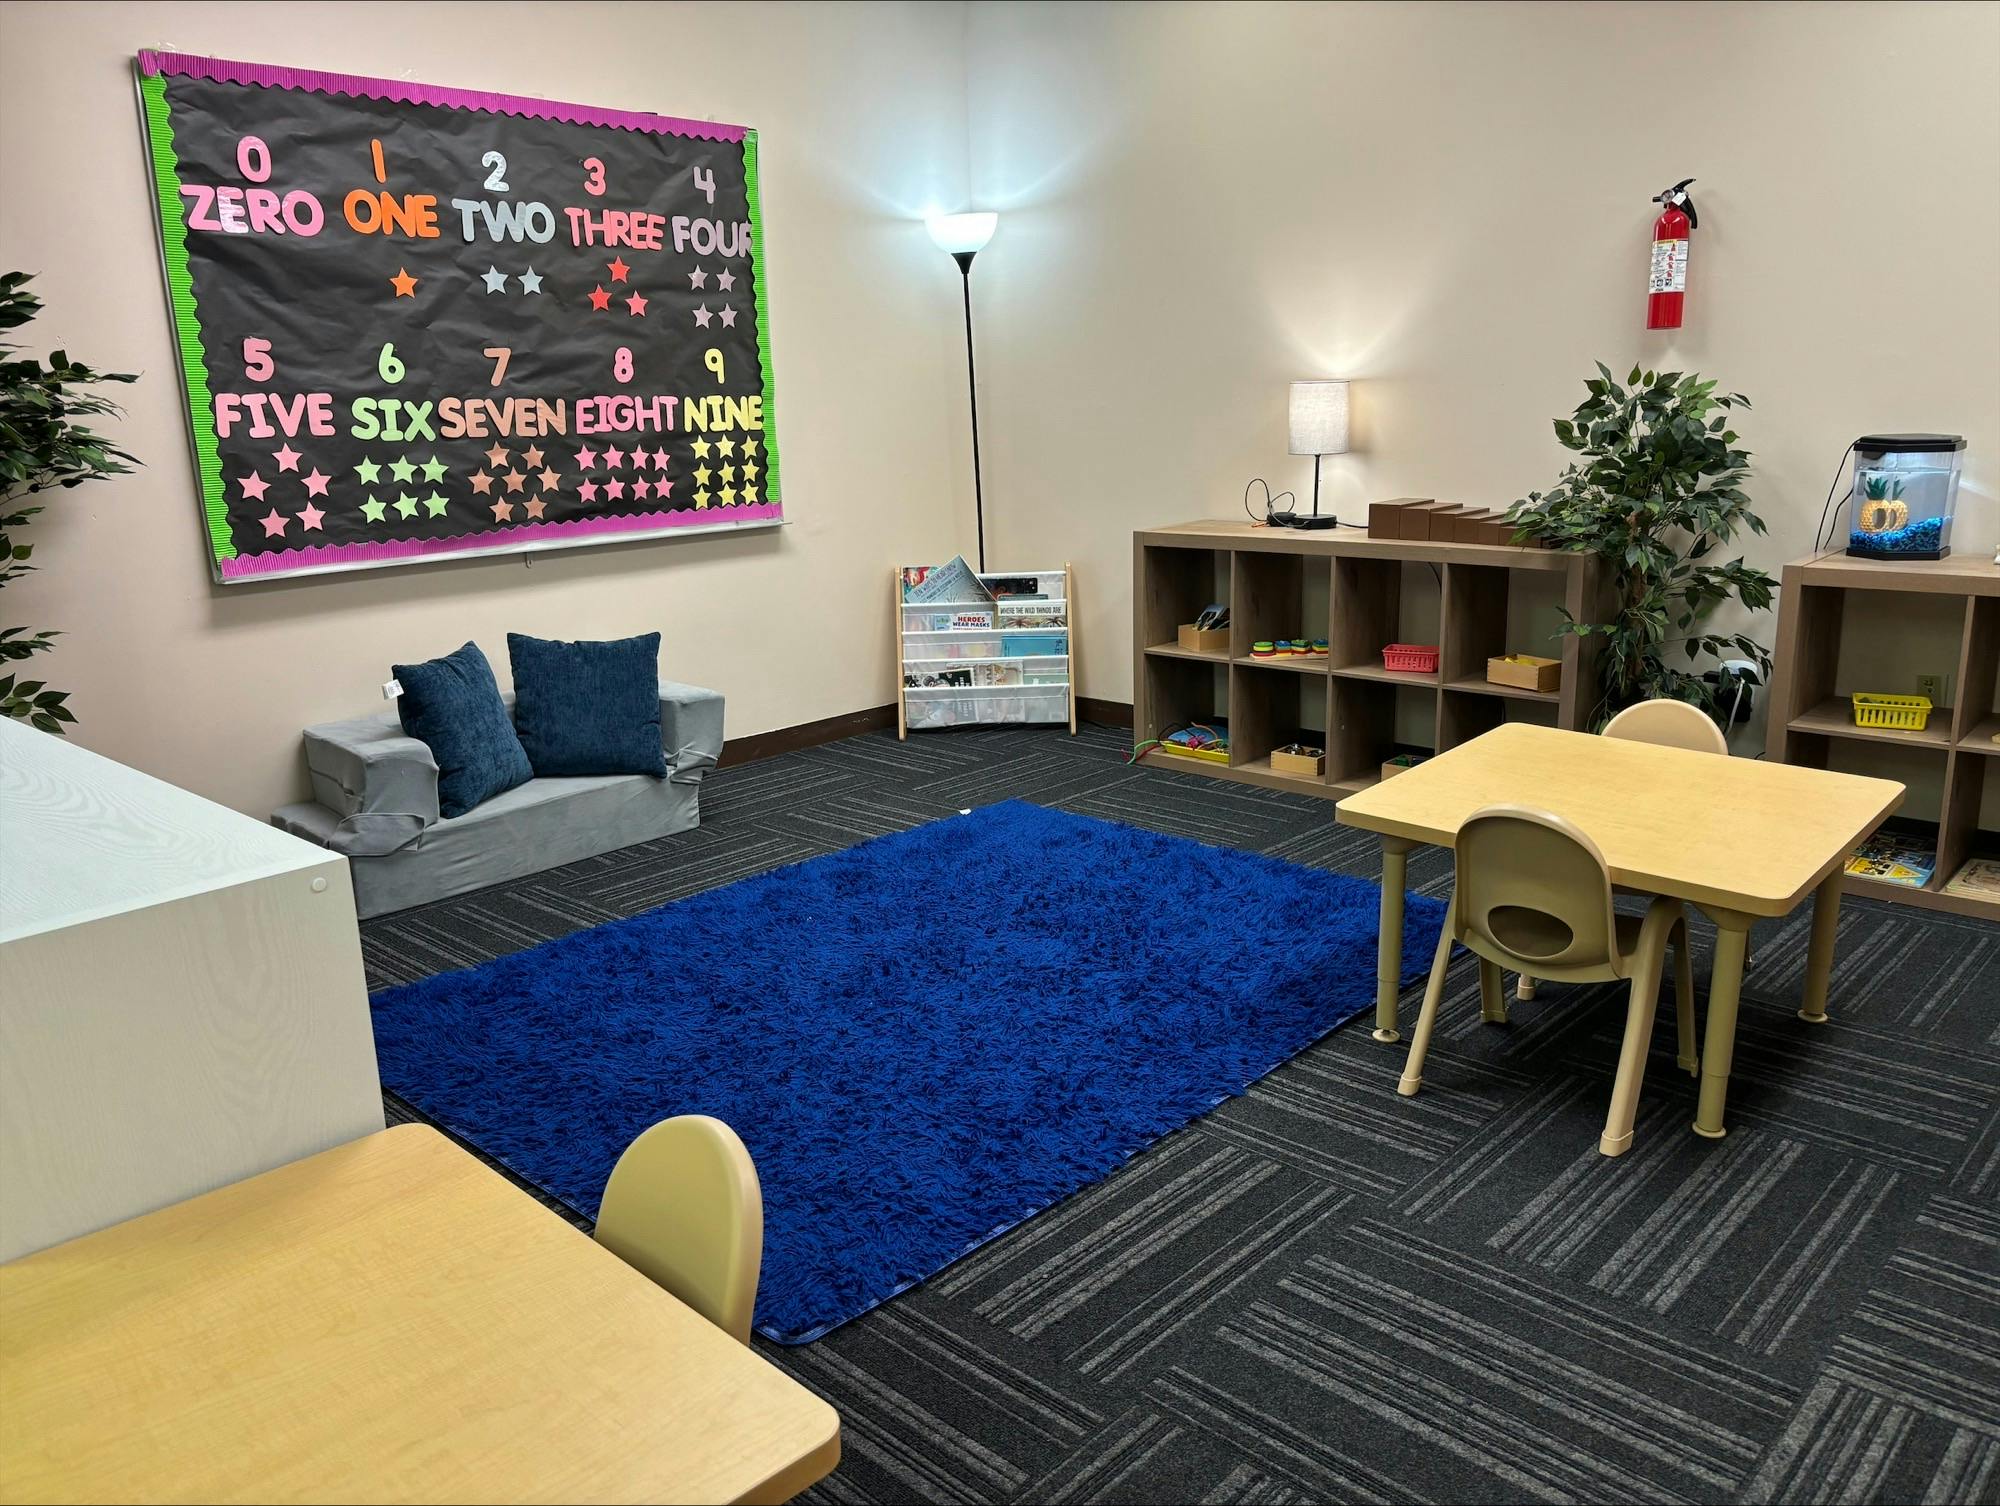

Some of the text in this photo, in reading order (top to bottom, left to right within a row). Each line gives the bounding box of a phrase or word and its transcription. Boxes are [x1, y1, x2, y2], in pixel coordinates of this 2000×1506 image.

[237, 136, 271, 182] 0
[482, 151, 509, 191] 2
[584, 157, 606, 195] 3
[694, 167, 716, 204] 4
[180, 181, 324, 238] ZERO
[344, 189, 440, 237] ONE
[451, 198, 555, 243] TWO
[564, 207, 665, 250] THREE
[244, 338, 724, 386] 5 6 7 8 9
[215, 393, 763, 441] FIVE SIX SEVEN EIGHT NINE
